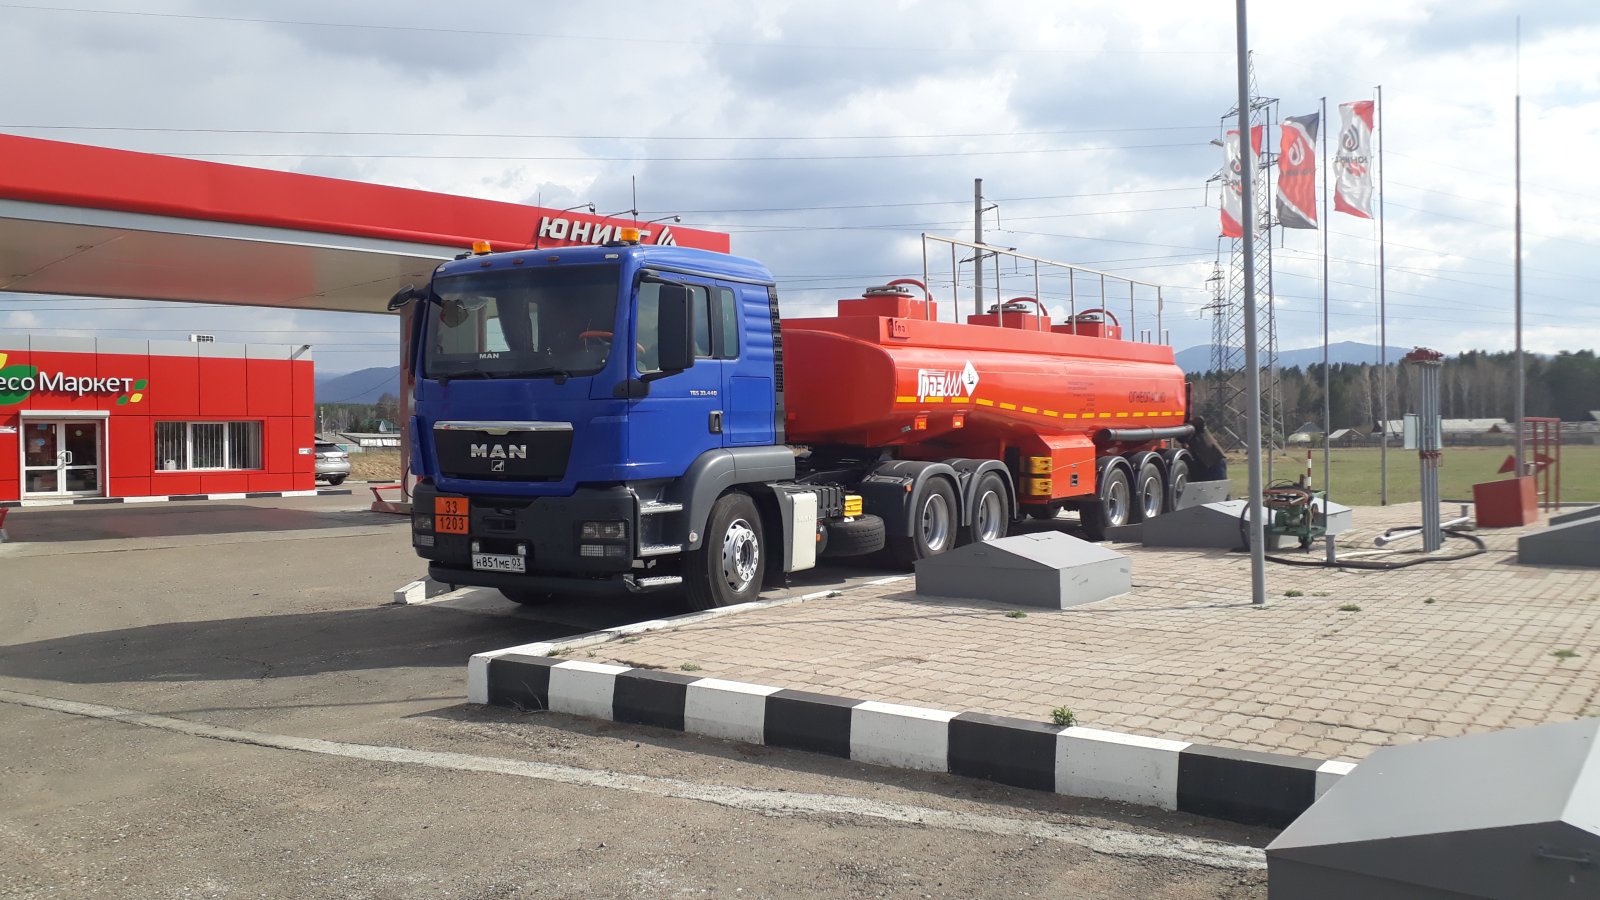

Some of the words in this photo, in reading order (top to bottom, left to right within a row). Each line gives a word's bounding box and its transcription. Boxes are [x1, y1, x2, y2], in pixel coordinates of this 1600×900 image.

[39, 371, 134, 397] Маркет
[470, 443, 527, 459] MAN
[445, 500, 458, 514] 33
[440, 516, 464, 530] 1203
